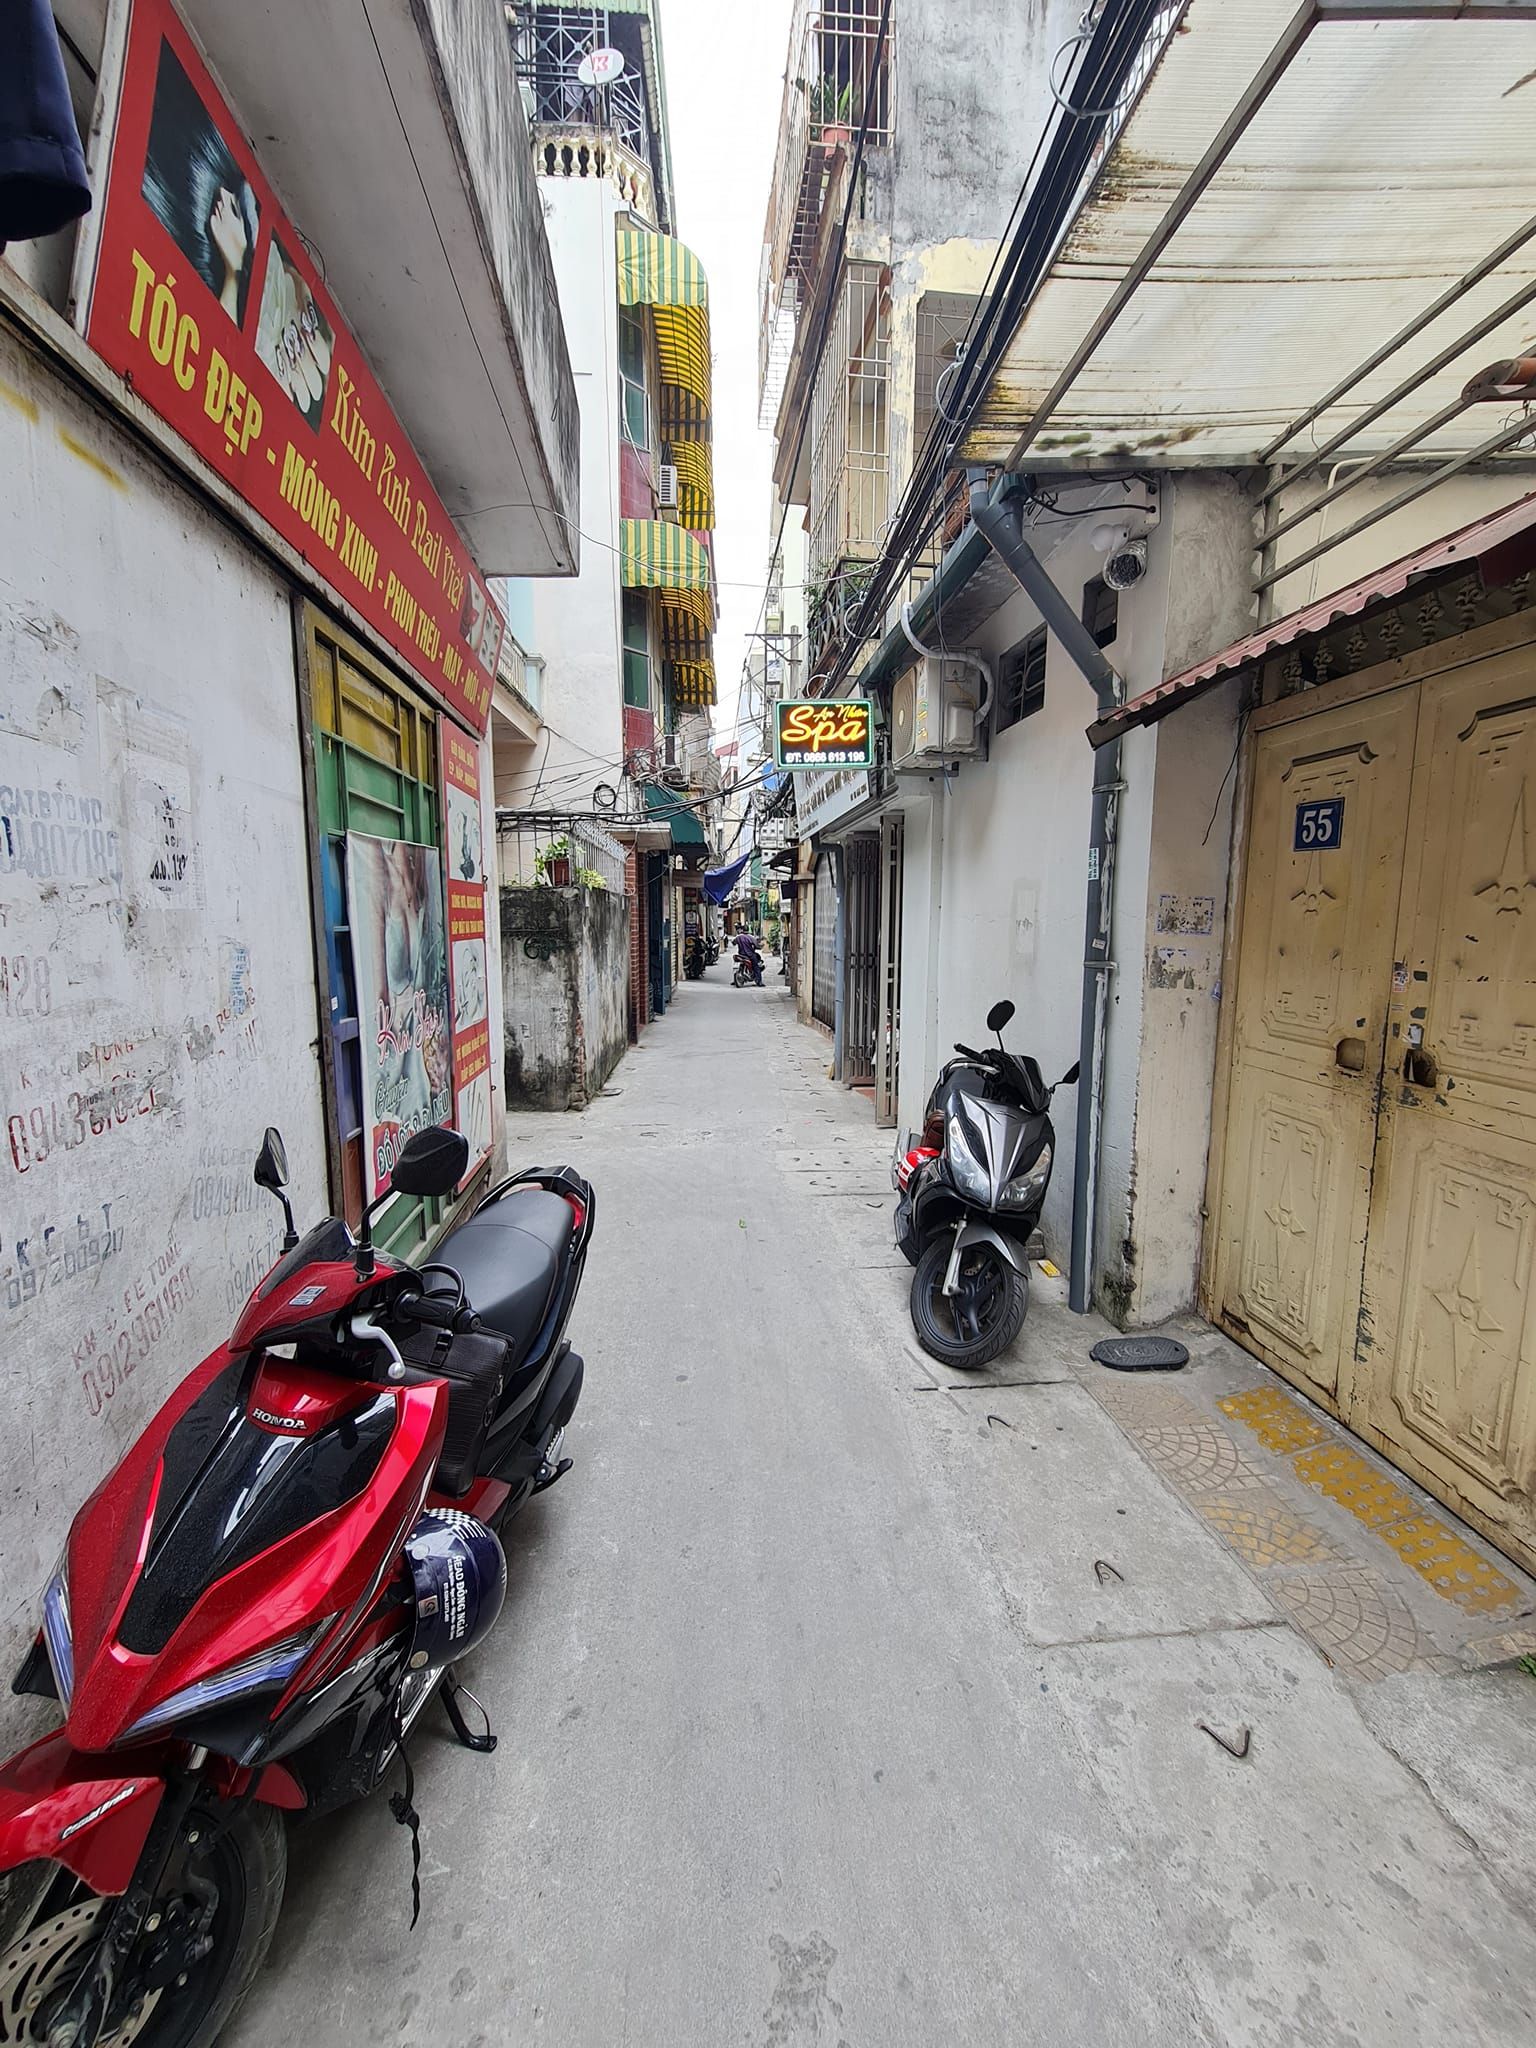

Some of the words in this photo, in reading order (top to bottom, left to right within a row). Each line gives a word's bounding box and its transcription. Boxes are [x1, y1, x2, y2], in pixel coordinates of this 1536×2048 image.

[129, 248, 200, 392] TÓC
[204, 347, 263, 457] ĐẸP
[279, 441, 341, 551] MÓNG
[338, 513, 378, 593] XINH
[384, 570, 418, 638] PHUN
[414, 606, 441, 663] THÊU
[330, 364, 377, 482] Kim
[411, 499, 442, 579] Nail
[782, 706, 866, 752] Spa
[1302, 808, 1333, 843] 55
[252, 1407, 307, 1429] HONDA
